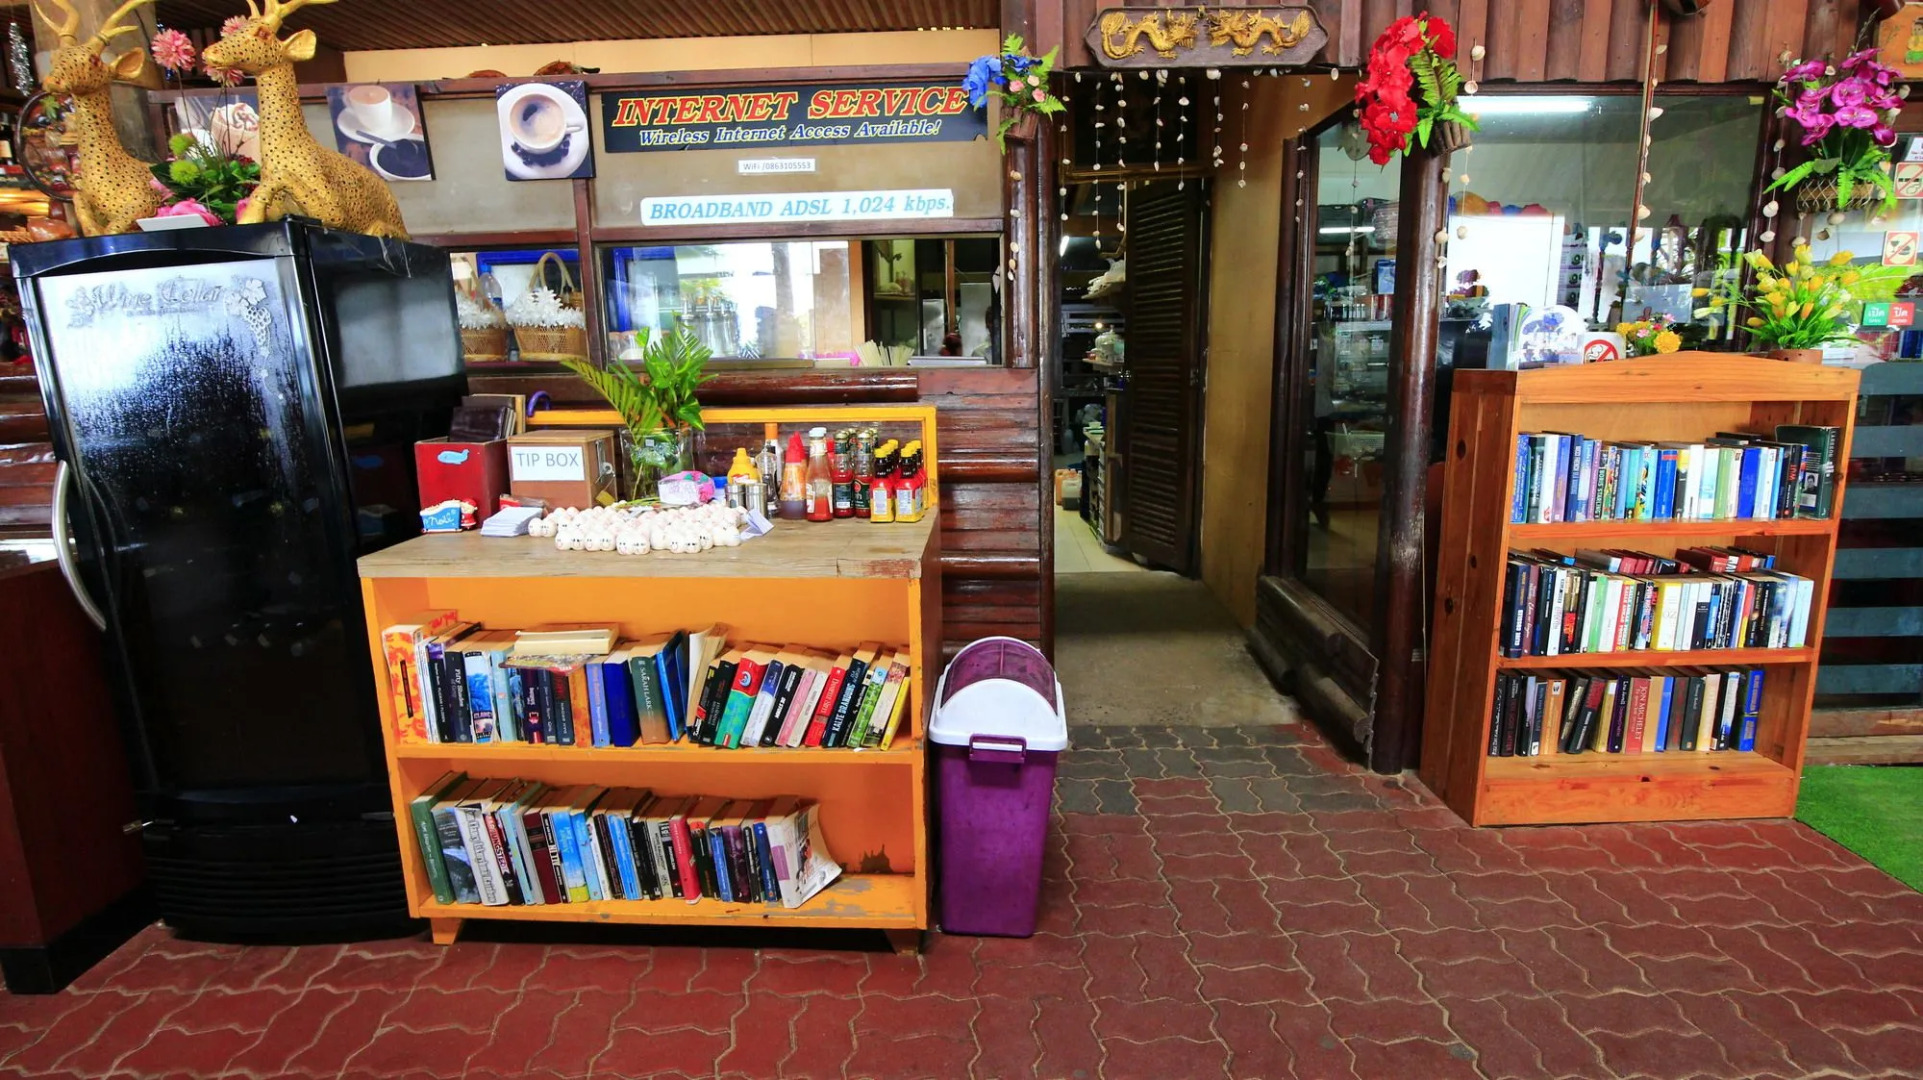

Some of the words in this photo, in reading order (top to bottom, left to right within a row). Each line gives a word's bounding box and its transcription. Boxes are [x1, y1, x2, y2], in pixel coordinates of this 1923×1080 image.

[611, 90, 799, 127] INTERNET
[807, 85, 971, 120] SERVICE
[639, 128, 708, 146] Wireless
[714, 125, 786, 142] Internet
[790, 123, 853, 140] Access
[855, 119, 942, 138] Available!
[649, 201, 773, 220] BROADBAND
[780, 200, 833, 216] ADSL
[841, 197, 895, 214] 1,024
[903, 195, 951, 213] kbps.
[515, 453, 541, 467] TIP
[546, 452, 579, 467] BOX
[1597, 469, 1606, 487] BORIS
[1594, 487, 1604, 515] STARLING
[453, 667, 463, 684] Fifty
[639, 666, 650, 692] SARAH
[456, 684, 466, 708] Shades
[643, 691, 653, 710] LARK
[1638, 686, 1648, 702] JON
[831, 712, 846, 733] KALTE
[1633, 702, 1646, 741] MICHELET
